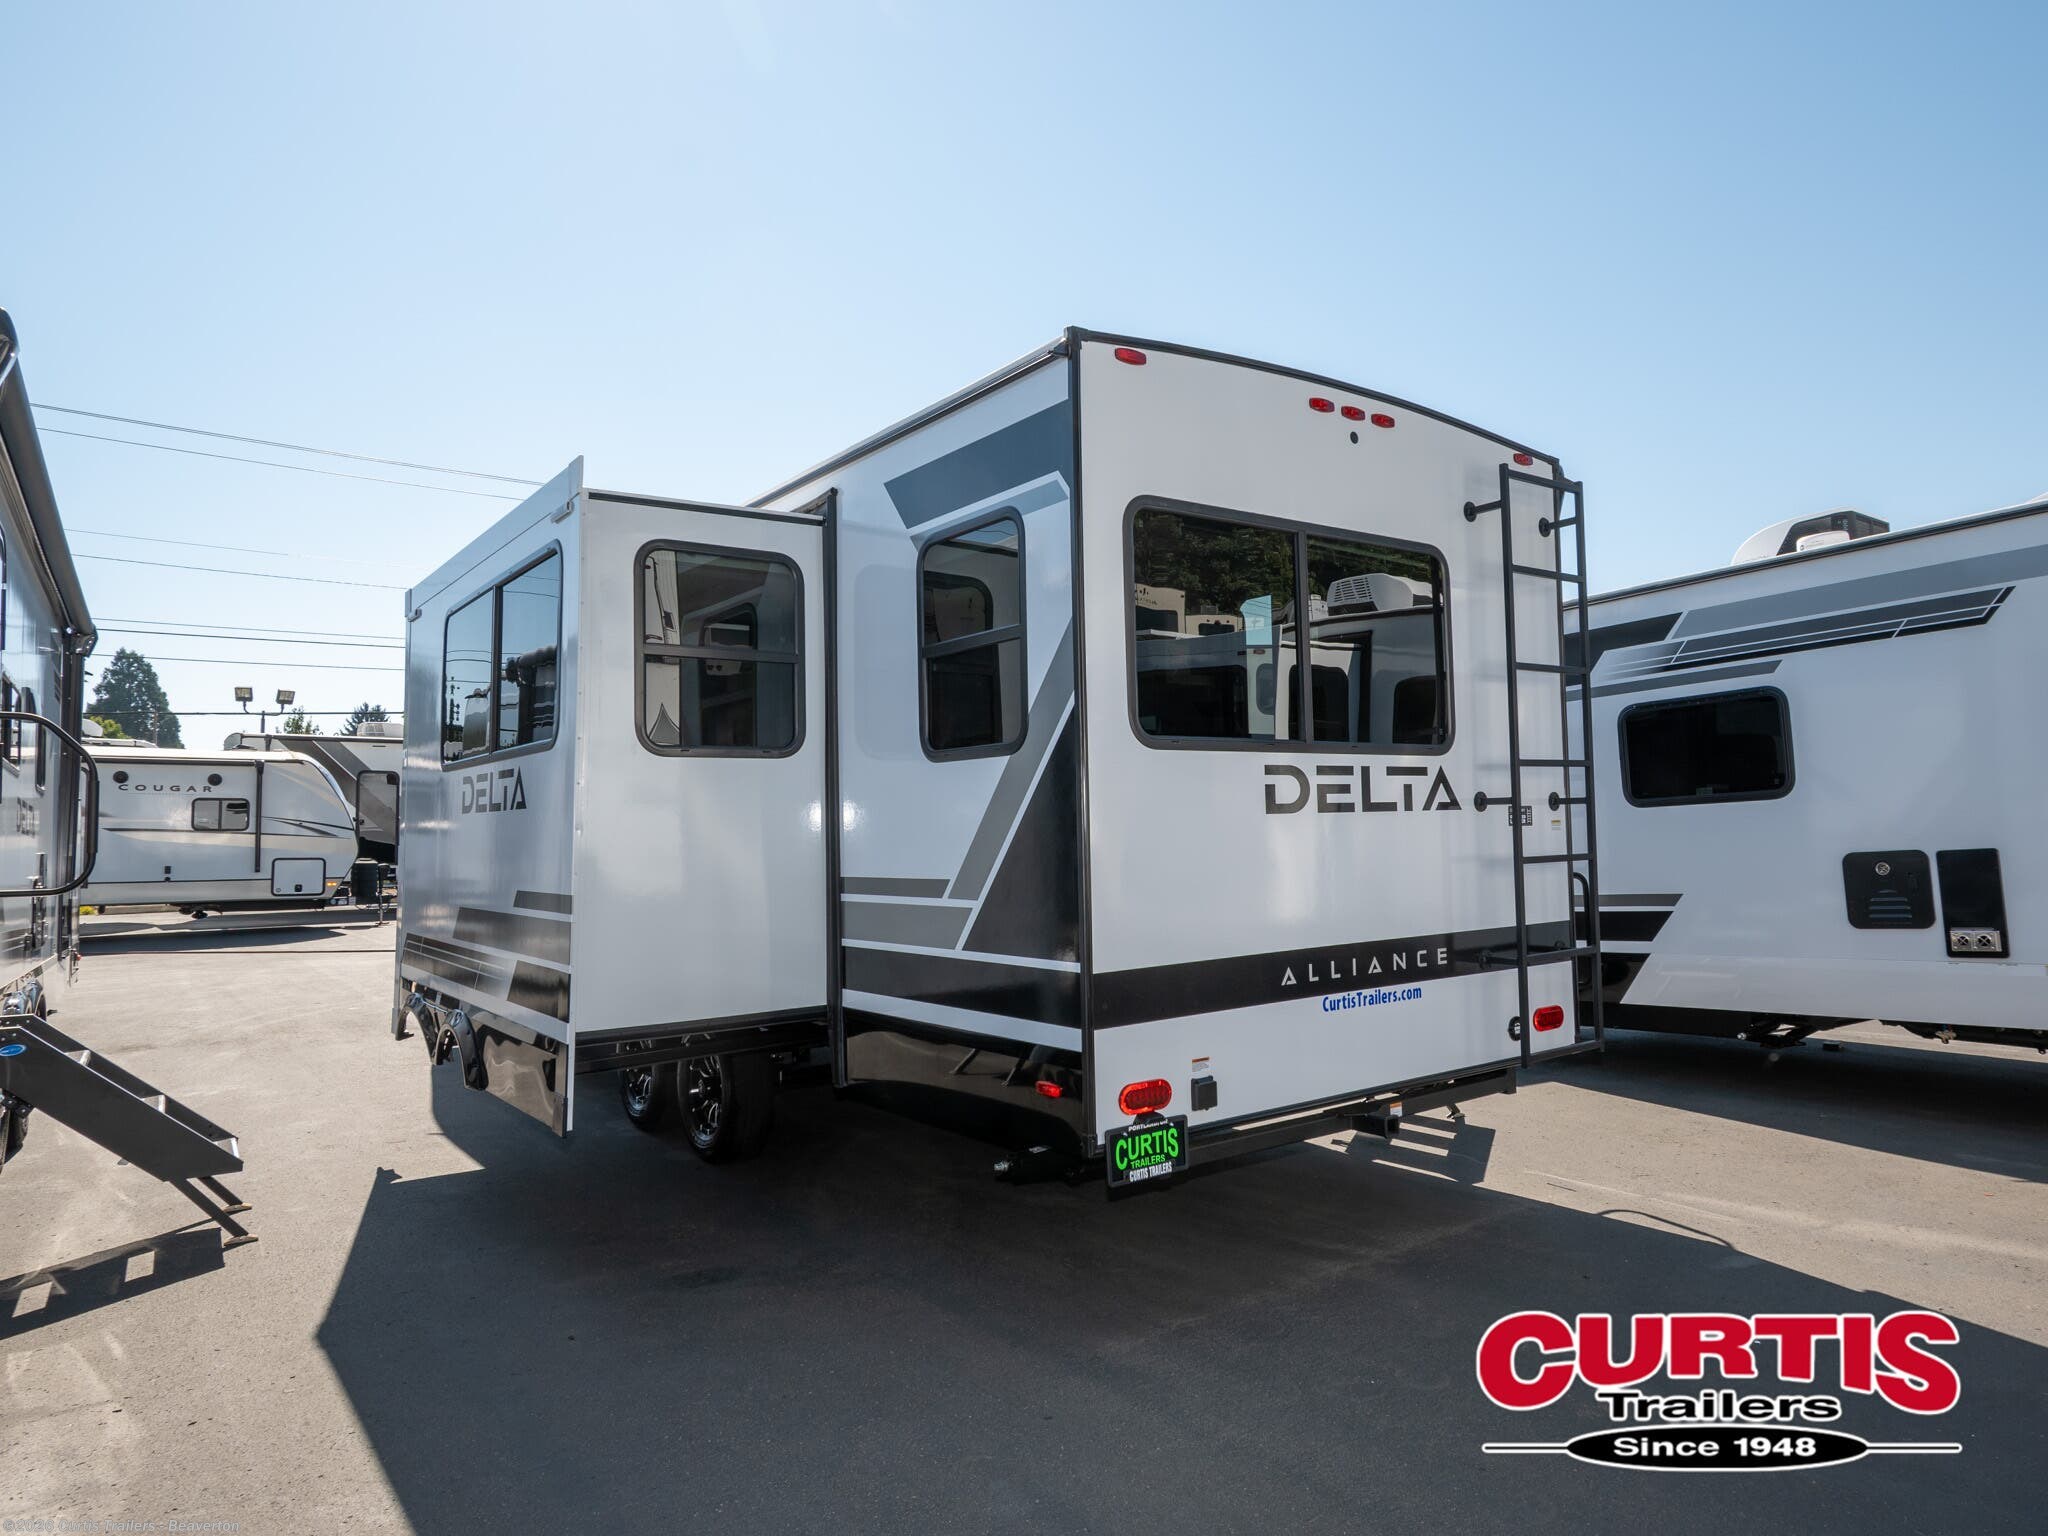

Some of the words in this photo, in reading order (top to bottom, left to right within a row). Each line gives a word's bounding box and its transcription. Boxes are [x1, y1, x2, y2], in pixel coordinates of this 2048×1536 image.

[118, 784, 212, 792] COUGAR
[461, 765, 527, 815] DELTA
[1264, 764, 1462, 814] DELTA
[1281, 948, 1448, 986] ALLIANCE
[1322, 987, 1422, 1012] CurtisTrailers.com
[1115, 1128, 1179, 1170] CURTIS
[1130, 1154, 1166, 1169] TRAILERS
[1129, 1168, 1149, 1182] CURTIS
[1149, 1161, 1173, 1177] TRAILERS
